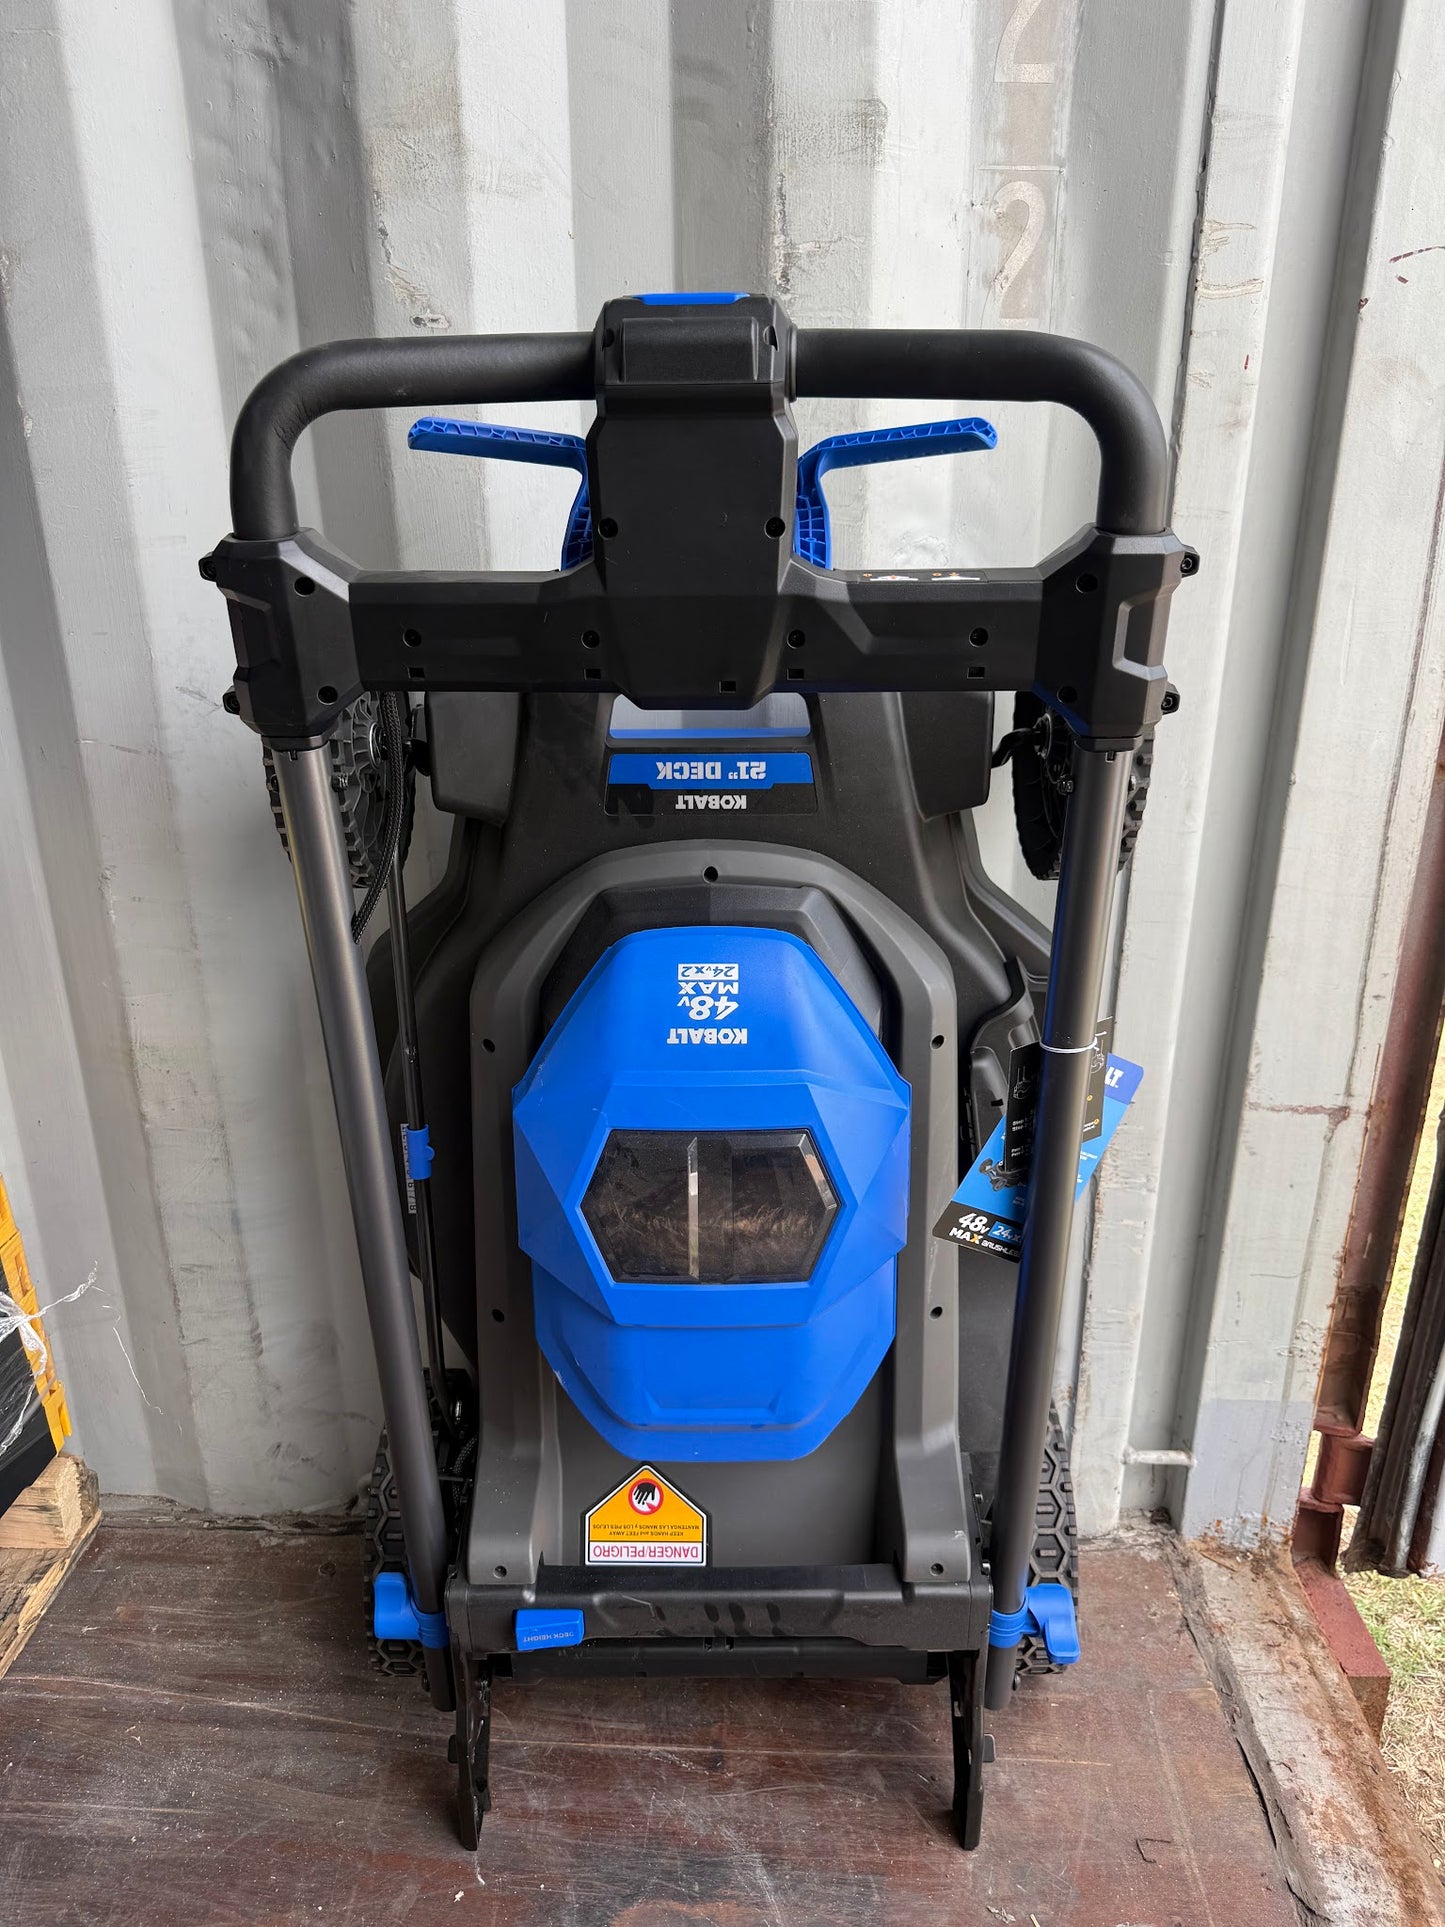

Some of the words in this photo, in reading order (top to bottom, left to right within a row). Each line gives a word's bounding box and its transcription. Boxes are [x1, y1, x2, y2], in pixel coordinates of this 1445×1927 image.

[656, 761, 722, 780] DECK
[675, 794, 747, 810] KOBALT
[678, 981, 739, 995] MAX
[667, 1028, 748, 1045] KOBALT
[949, 1227, 983, 1244] MAX
[522, 1633, 551, 1642] HEIGHT
